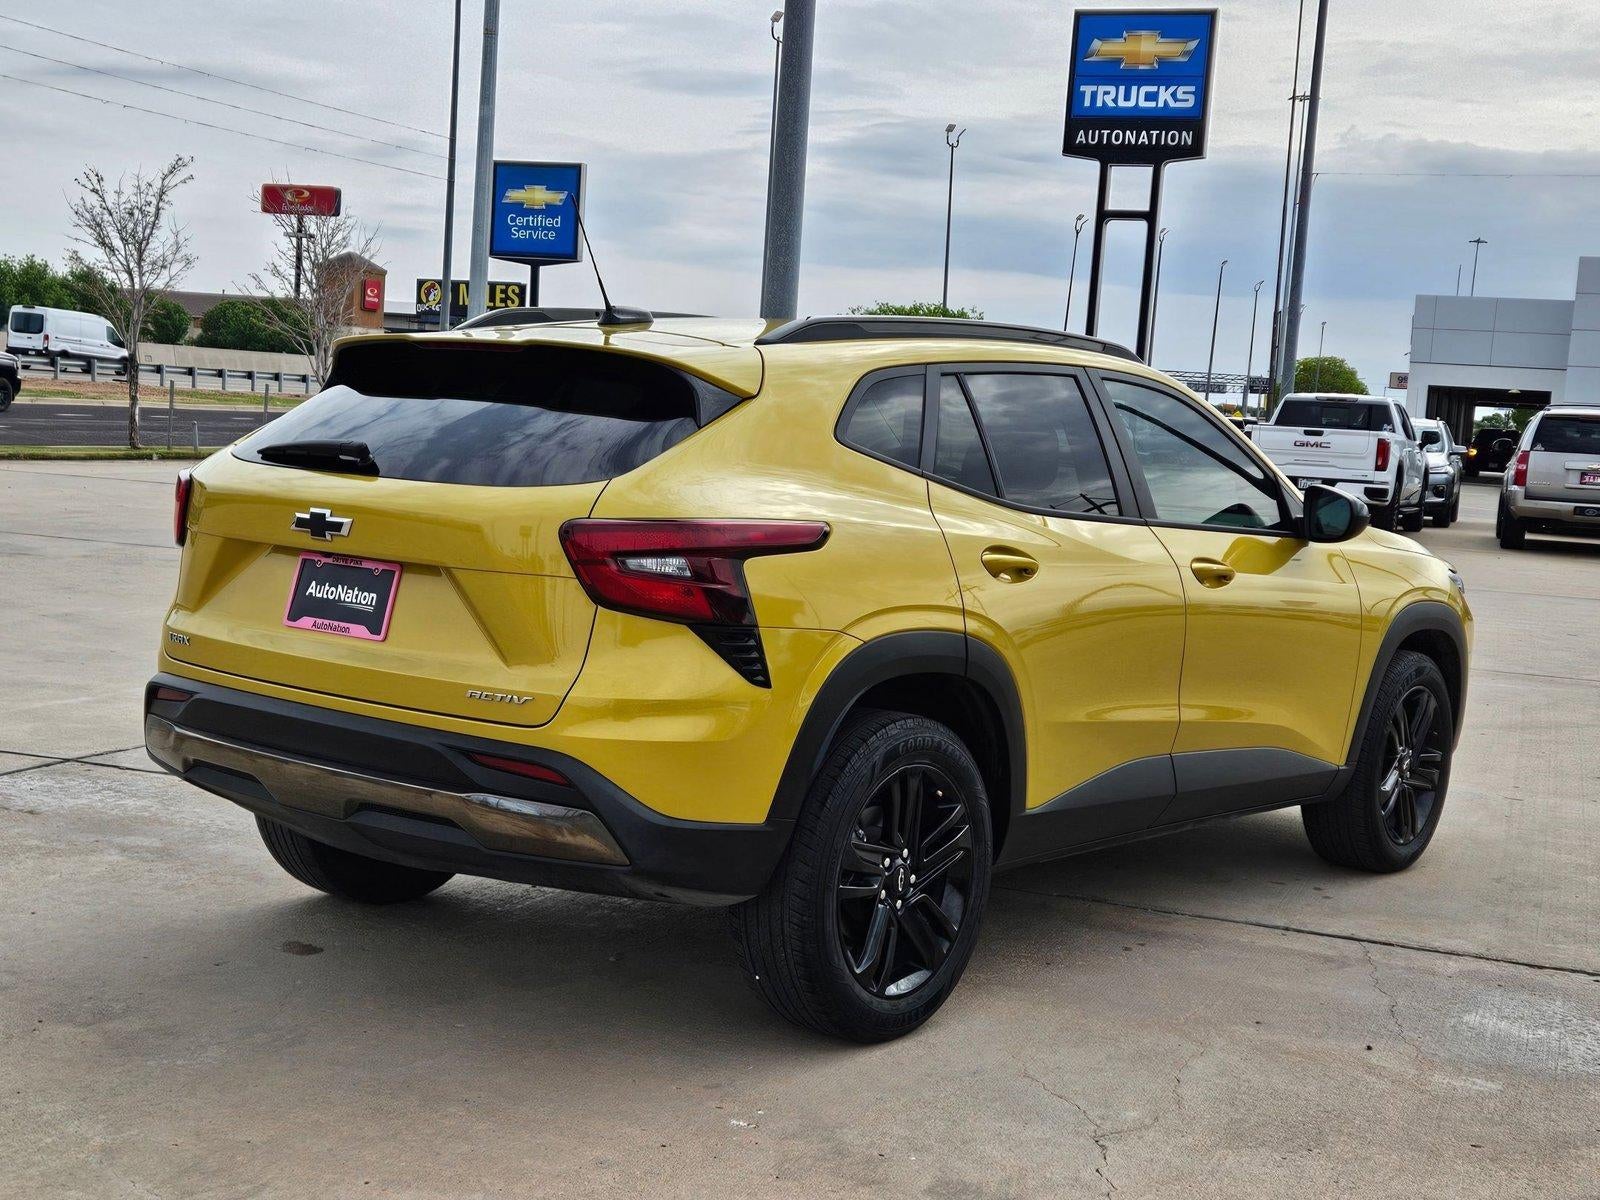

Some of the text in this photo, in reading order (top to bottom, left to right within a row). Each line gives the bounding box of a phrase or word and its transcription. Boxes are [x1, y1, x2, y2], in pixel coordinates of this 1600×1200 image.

[1080, 85, 1196, 107] TRUCKS
[1076, 130, 1193, 145] AUTONATION
[507, 214, 561, 227] Certified
[511, 227, 556, 240] Service
[459, 284, 520, 307] MLES
[1293, 440, 1332, 449] GMC
[305, 580, 377, 605] AutoNation
[311, 620, 351, 634] AutoNation
[465, 689, 535, 705] ACTIV
